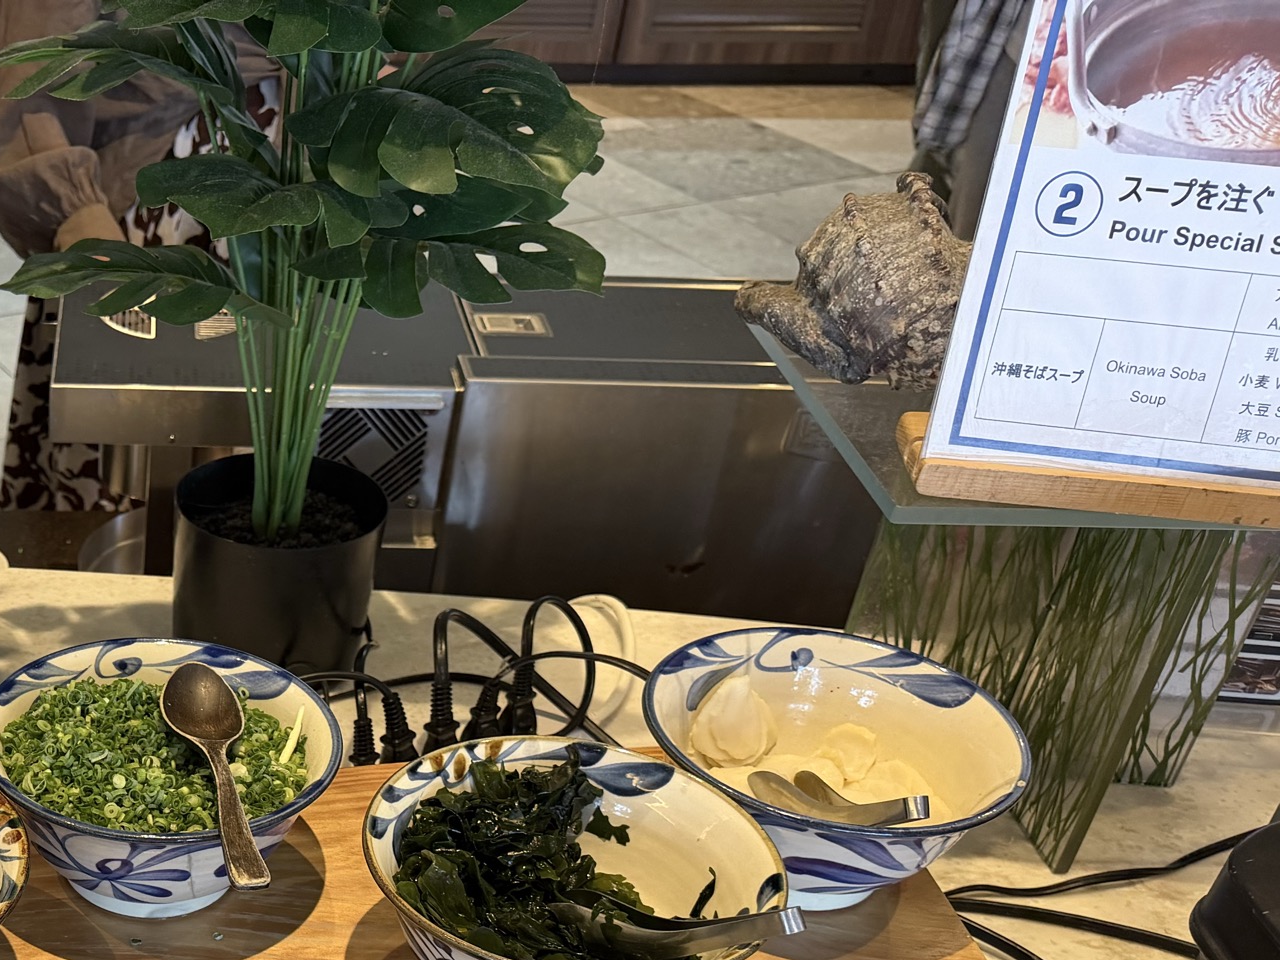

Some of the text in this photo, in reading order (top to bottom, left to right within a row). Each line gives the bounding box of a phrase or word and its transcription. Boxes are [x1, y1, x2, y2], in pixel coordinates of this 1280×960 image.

[1052, 183, 1084, 225] 2
[1118, 176, 1275, 215] スープを注ぐ
[1108, 220, 1168, 245] Pour
[1173, 226, 1263, 253] Special
[1264, 347, 1279, 362] 乳
[991, 361, 1085, 384] 沖縄そばスープ
[1106, 359, 1207, 382] Okinawa Soba
[1238, 373, 1270, 389] 小麦
[1129, 391, 1166, 407] Soup
[1238, 401, 1271, 417] 大豆
[1235, 428, 1252, 443] 豚
